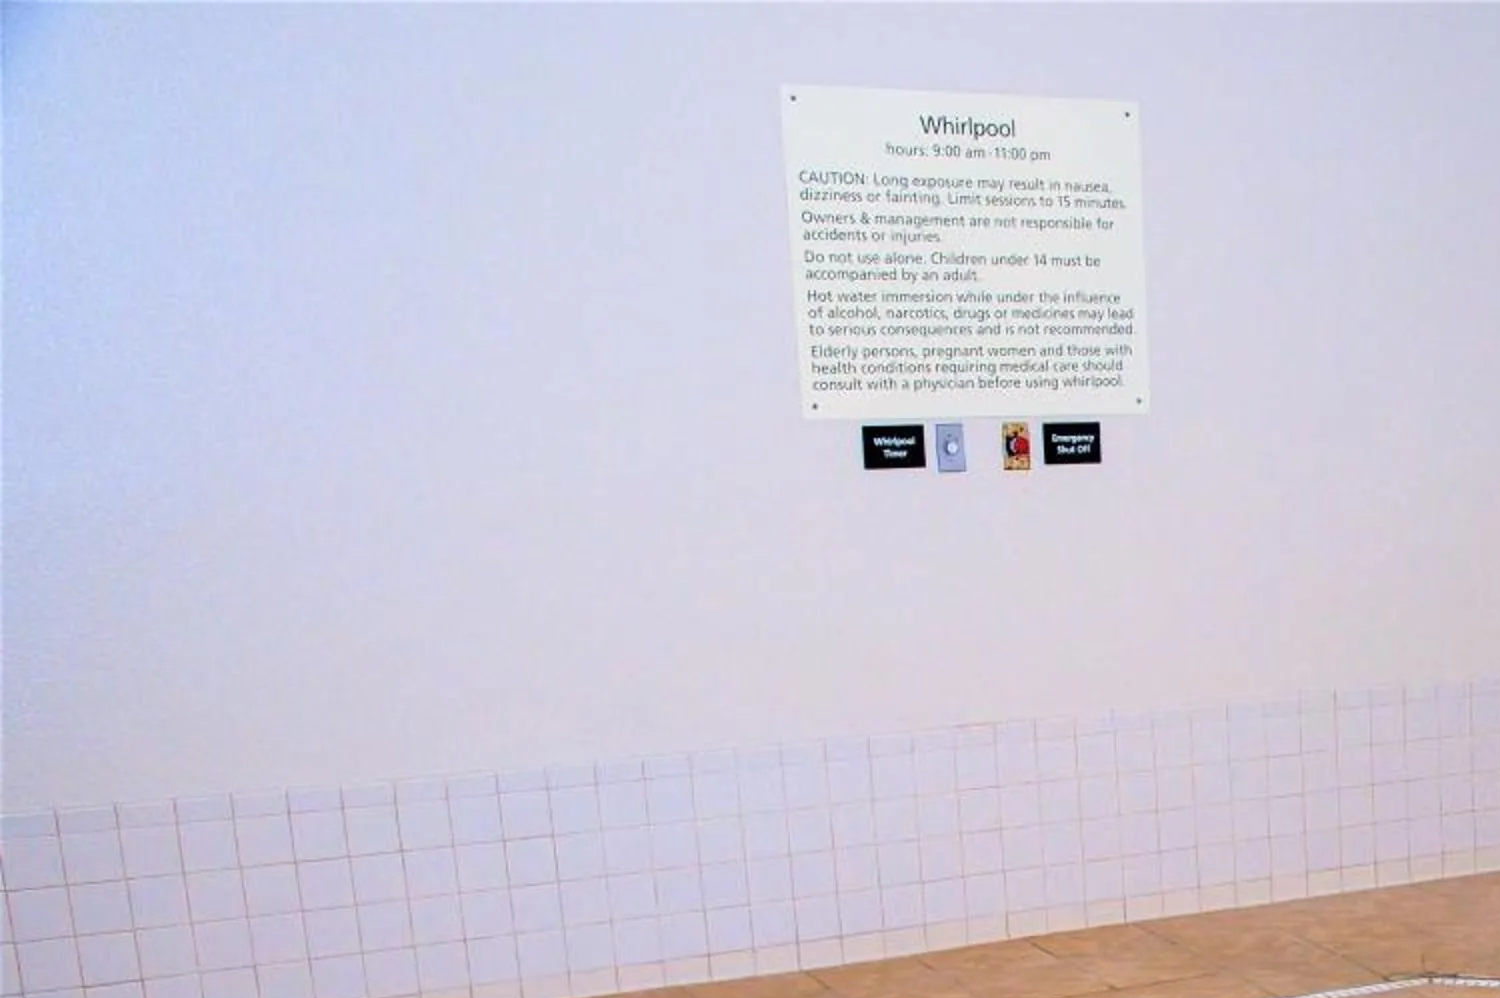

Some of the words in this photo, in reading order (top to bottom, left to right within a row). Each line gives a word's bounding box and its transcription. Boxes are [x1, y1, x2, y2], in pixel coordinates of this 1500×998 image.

[919, 114, 1016, 140] Whirlpool
[885, 142, 929, 157] hours:
[931, 143, 961, 158] 9:00
[965, 148, 986, 158] am
[995, 147, 1027, 160] 11:00
[1030, 151, 1051, 162] pm
[873, 173, 909, 189] Long
[912, 177, 975, 191] exposure
[977, 179, 1005, 192] may
[1008, 178, 1045, 191] result
[1048, 181, 1061, 191] in
[799, 188, 862, 202] dizziness
[867, 193, 881, 202] or
[947, 192, 982, 205] Limit
[984, 194, 1037, 206] sessions
[1039, 196, 1053, 207] to
[1058, 194, 1071, 207] 15
[801, 212, 856, 225] Owners
[860, 213, 871, 225] &
[875, 215, 965, 230] management
[968, 218, 990, 228] are
[994, 216, 1017, 228] not
[1020, 216, 1092, 232] responsible
[1096, 217, 1114, 230] for
[803, 229, 868, 242] accidents
[871, 232, 886, 242] or
[803, 251, 824, 263] Do
[828, 252, 852, 264] not
[857, 254, 880, 264] use
[930, 252, 987, 265] Children
[991, 254, 1028, 266] under
[1033, 254, 1047, 266] 14
[1050, 256, 1082, 267] must
[1085, 255, 1101, 267] be
[805, 269, 897, 281] accompanied
[901, 269, 918, 284] by
[921, 272, 938, 281] an
[807, 290, 833, 302] Hot
[838, 291, 877, 302] water
[881, 291, 953, 302] immersion
[955, 290, 992, 303] while
[996, 291, 1034, 303] under
[1039, 291, 1060, 303] the
[1063, 291, 1121, 303] influence
[807, 306, 823, 319] of
[952, 306, 991, 322] drugs
[993, 309, 1007, 319] or
[1010, 306, 1075, 319] medicines
[1077, 309, 1104, 322] may
[1107, 307, 1135, 319] lead
[809, 325, 824, 336] to
[828, 324, 877, 336] serious
[880, 325, 973, 337] consequences
[976, 323, 1001, 335] and
[1005, 325, 1014, 335] is
[1018, 324, 1040, 335] not
[811, 344, 858, 360] Elderly
[921, 346, 984, 360] pregnant
[987, 347, 1036, 357] women
[1039, 344, 1064, 356] and
[1066, 344, 1100, 356] those
[1103, 344, 1133, 356] with
[811, 361, 856, 374] health
[860, 360, 931, 374] conditions
[934, 361, 996, 376] requiring
[999, 359, 1049, 372] medical
[1052, 362, 1079, 372] care
[1081, 359, 1123, 372] should
[812, 377, 862, 390] consult
[866, 377, 897, 390] with
[901, 379, 909, 389] a
[913, 376, 974, 392] physician
[977, 375, 1021, 389] before
[1024, 376, 1060, 391] using
[1051, 433, 1095, 444] Emergency
